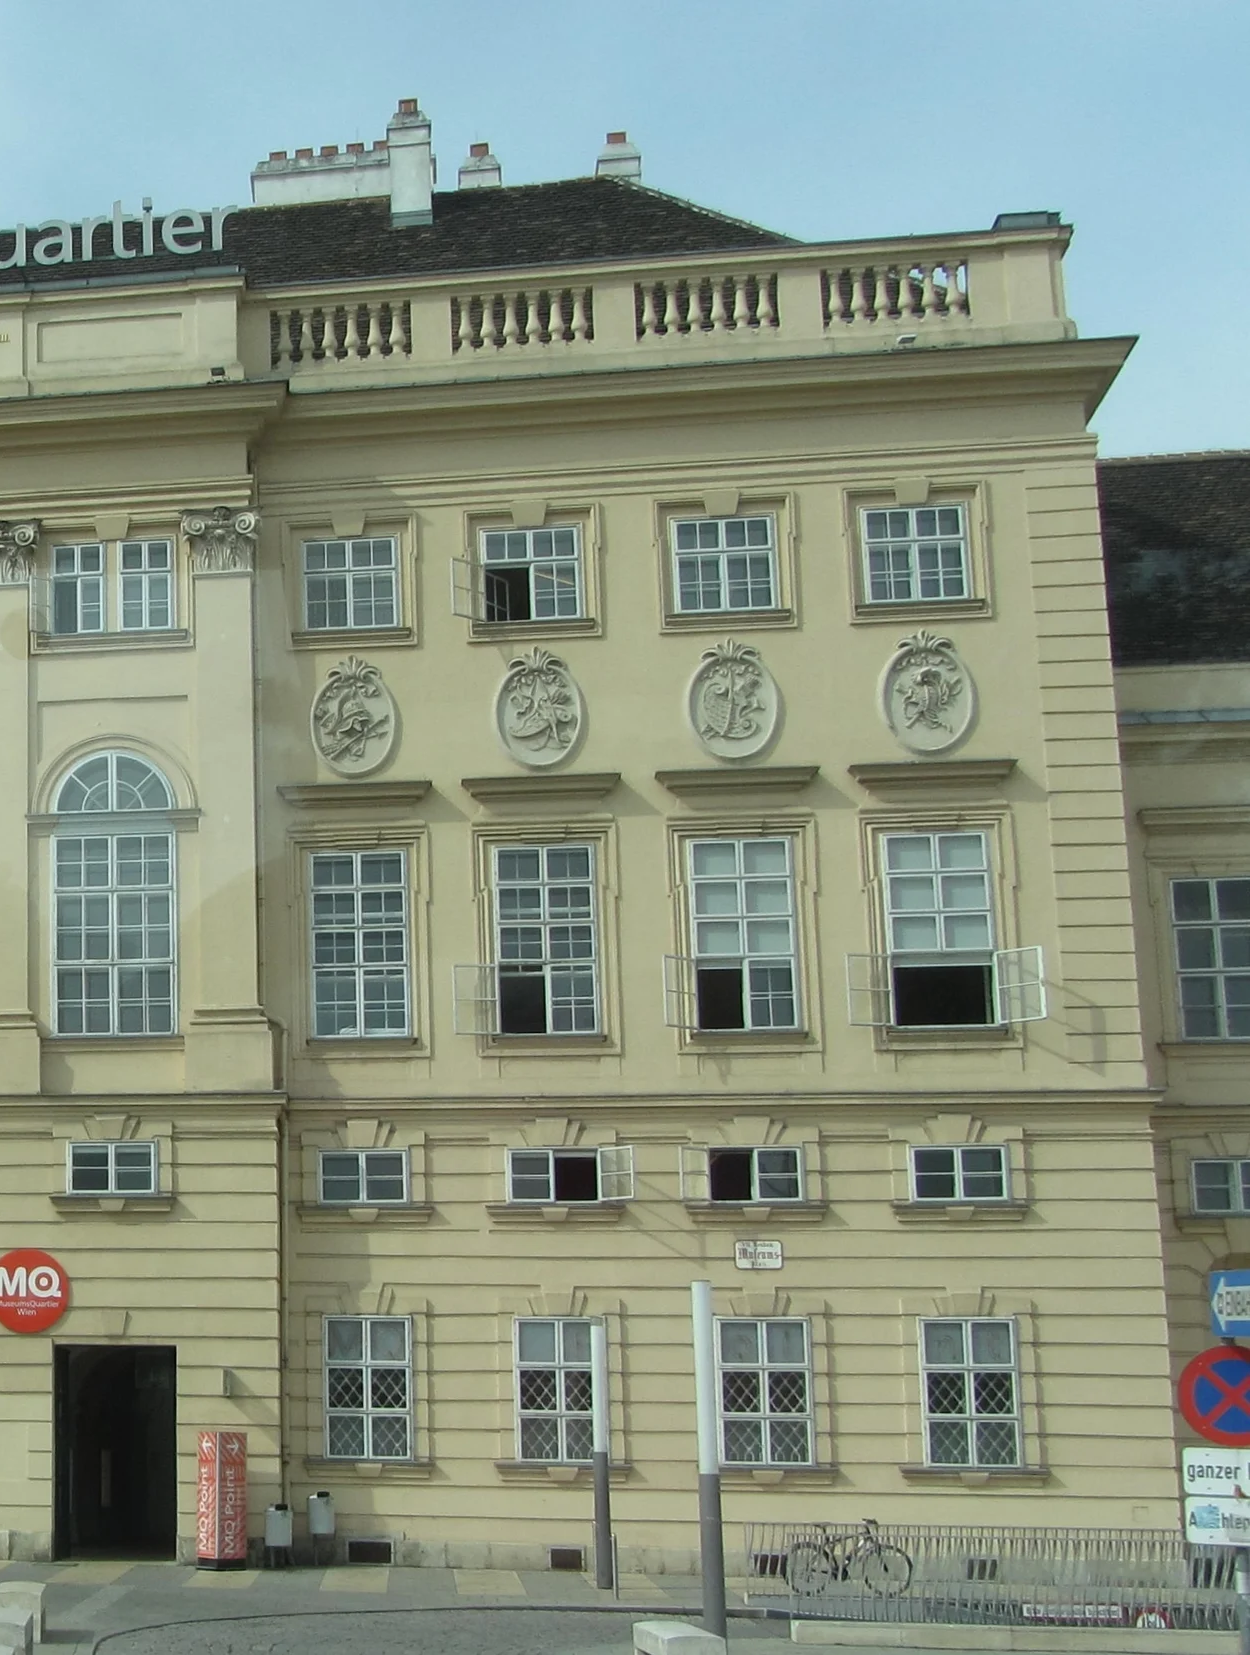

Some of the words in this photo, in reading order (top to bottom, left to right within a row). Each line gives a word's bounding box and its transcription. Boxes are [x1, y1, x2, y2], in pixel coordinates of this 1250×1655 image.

[16, 1308, 37, 1316] Wien
[199, 1465, 209, 1513] Point
[1187, 1464, 1241, 1482] ganzer
[224, 1468, 235, 1515] Point
[198, 1517, 208, 1550] MQ
[224, 1519, 236, 1553] MQ
[1189, 1510, 1250, 1530] Ahlep
